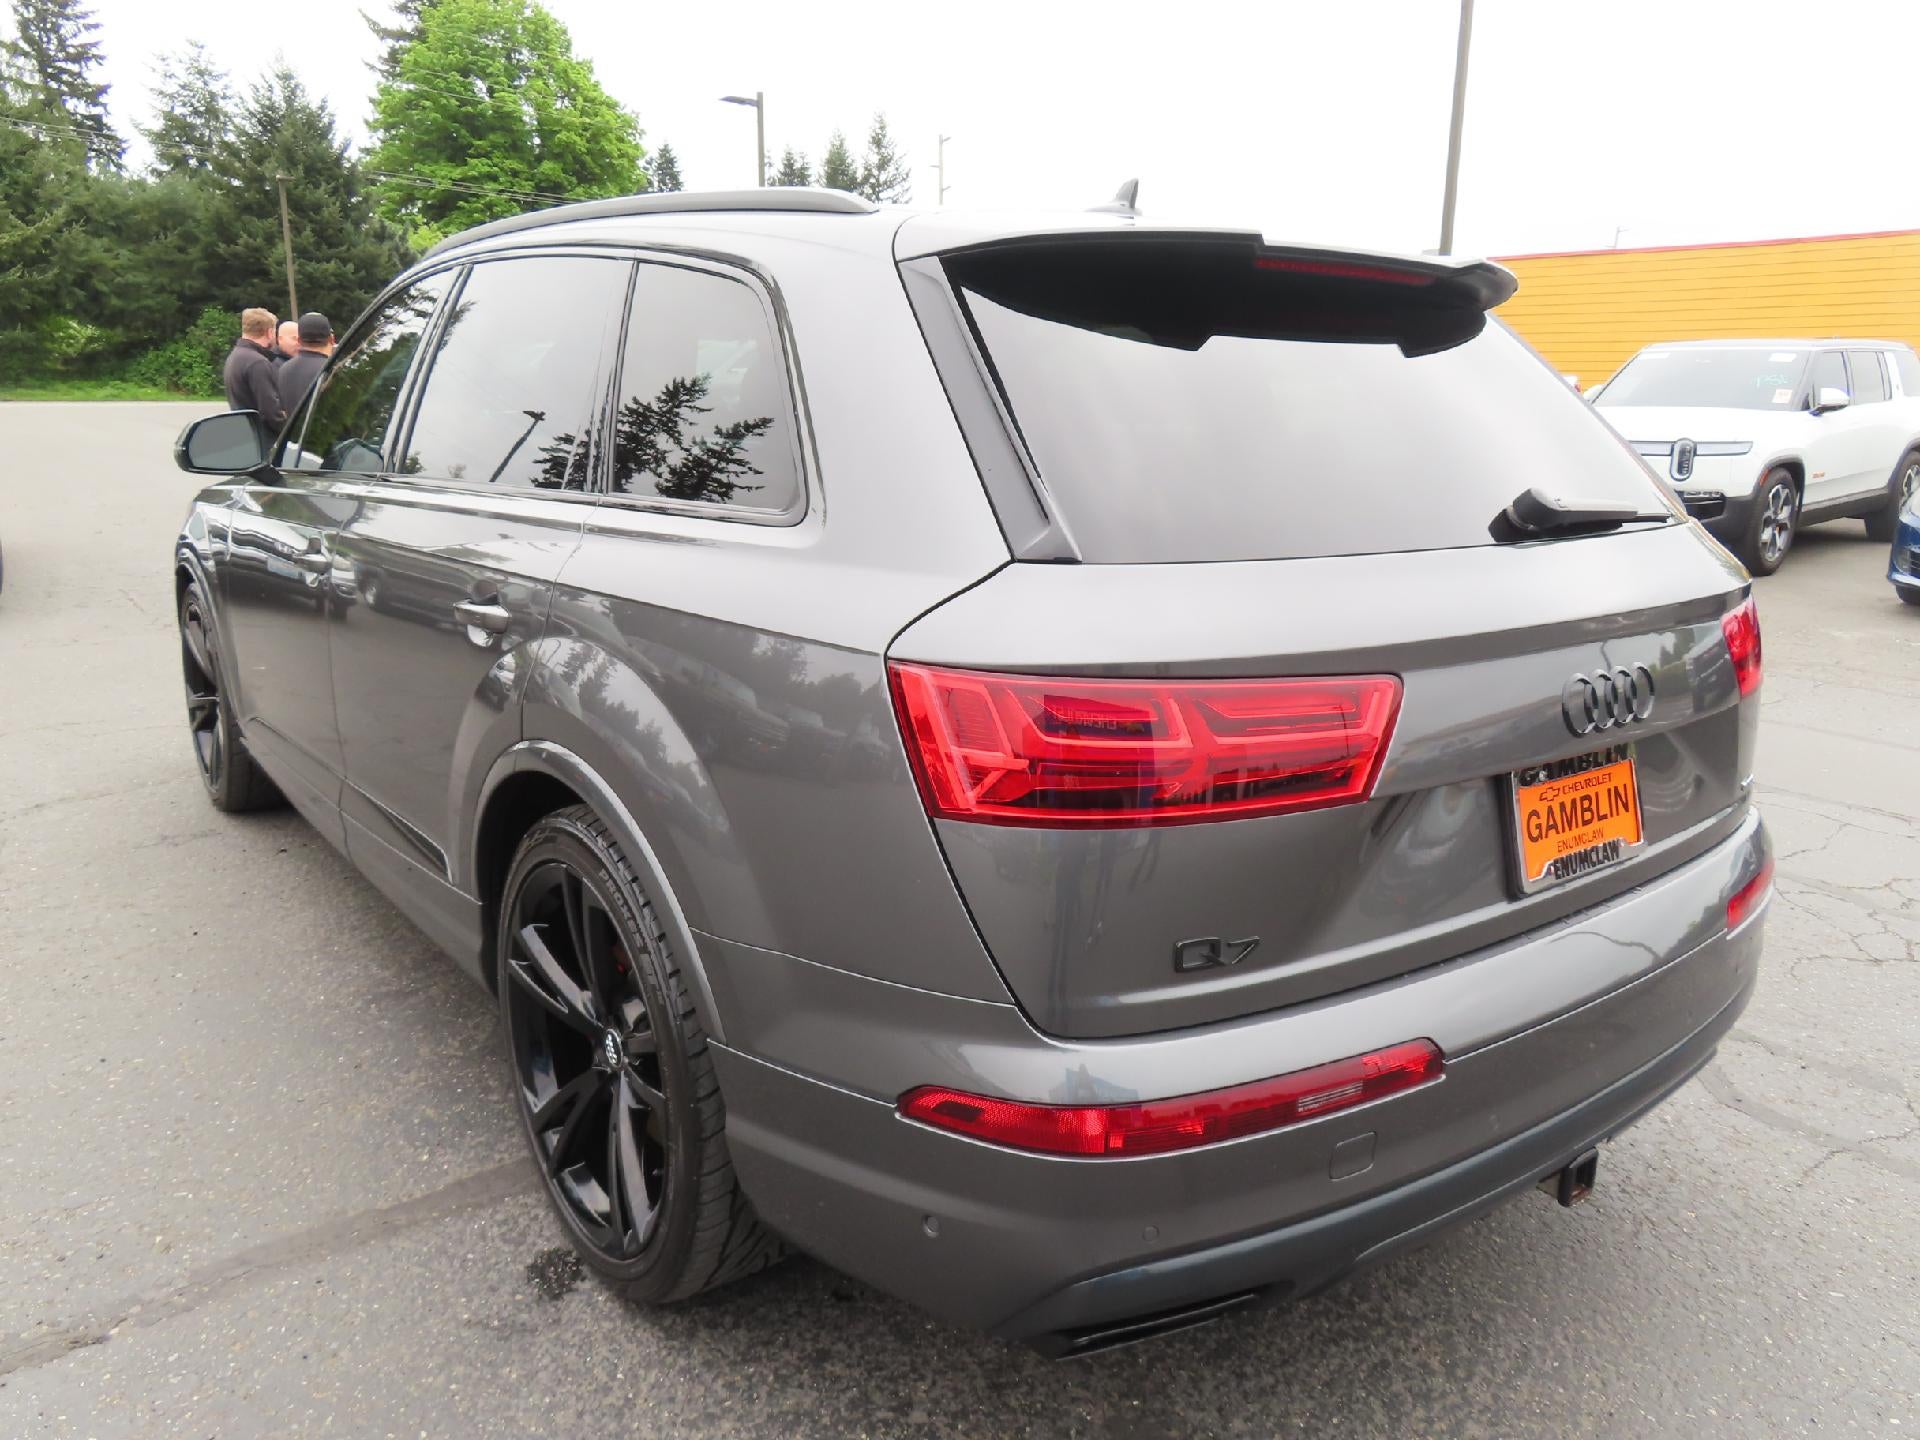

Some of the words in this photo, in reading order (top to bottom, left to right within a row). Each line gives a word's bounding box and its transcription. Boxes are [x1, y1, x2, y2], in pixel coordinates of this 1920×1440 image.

[1562, 772, 1612, 795] CHEVROLET
[1526, 783, 1630, 843] GAMBLIN
[1553, 838, 1620, 880] ENUMCLAW
[1557, 827, 1604, 852] ENUMCLAW
[598, 867, 644, 948] PROXES
[1174, 935, 1260, 973] Q7
